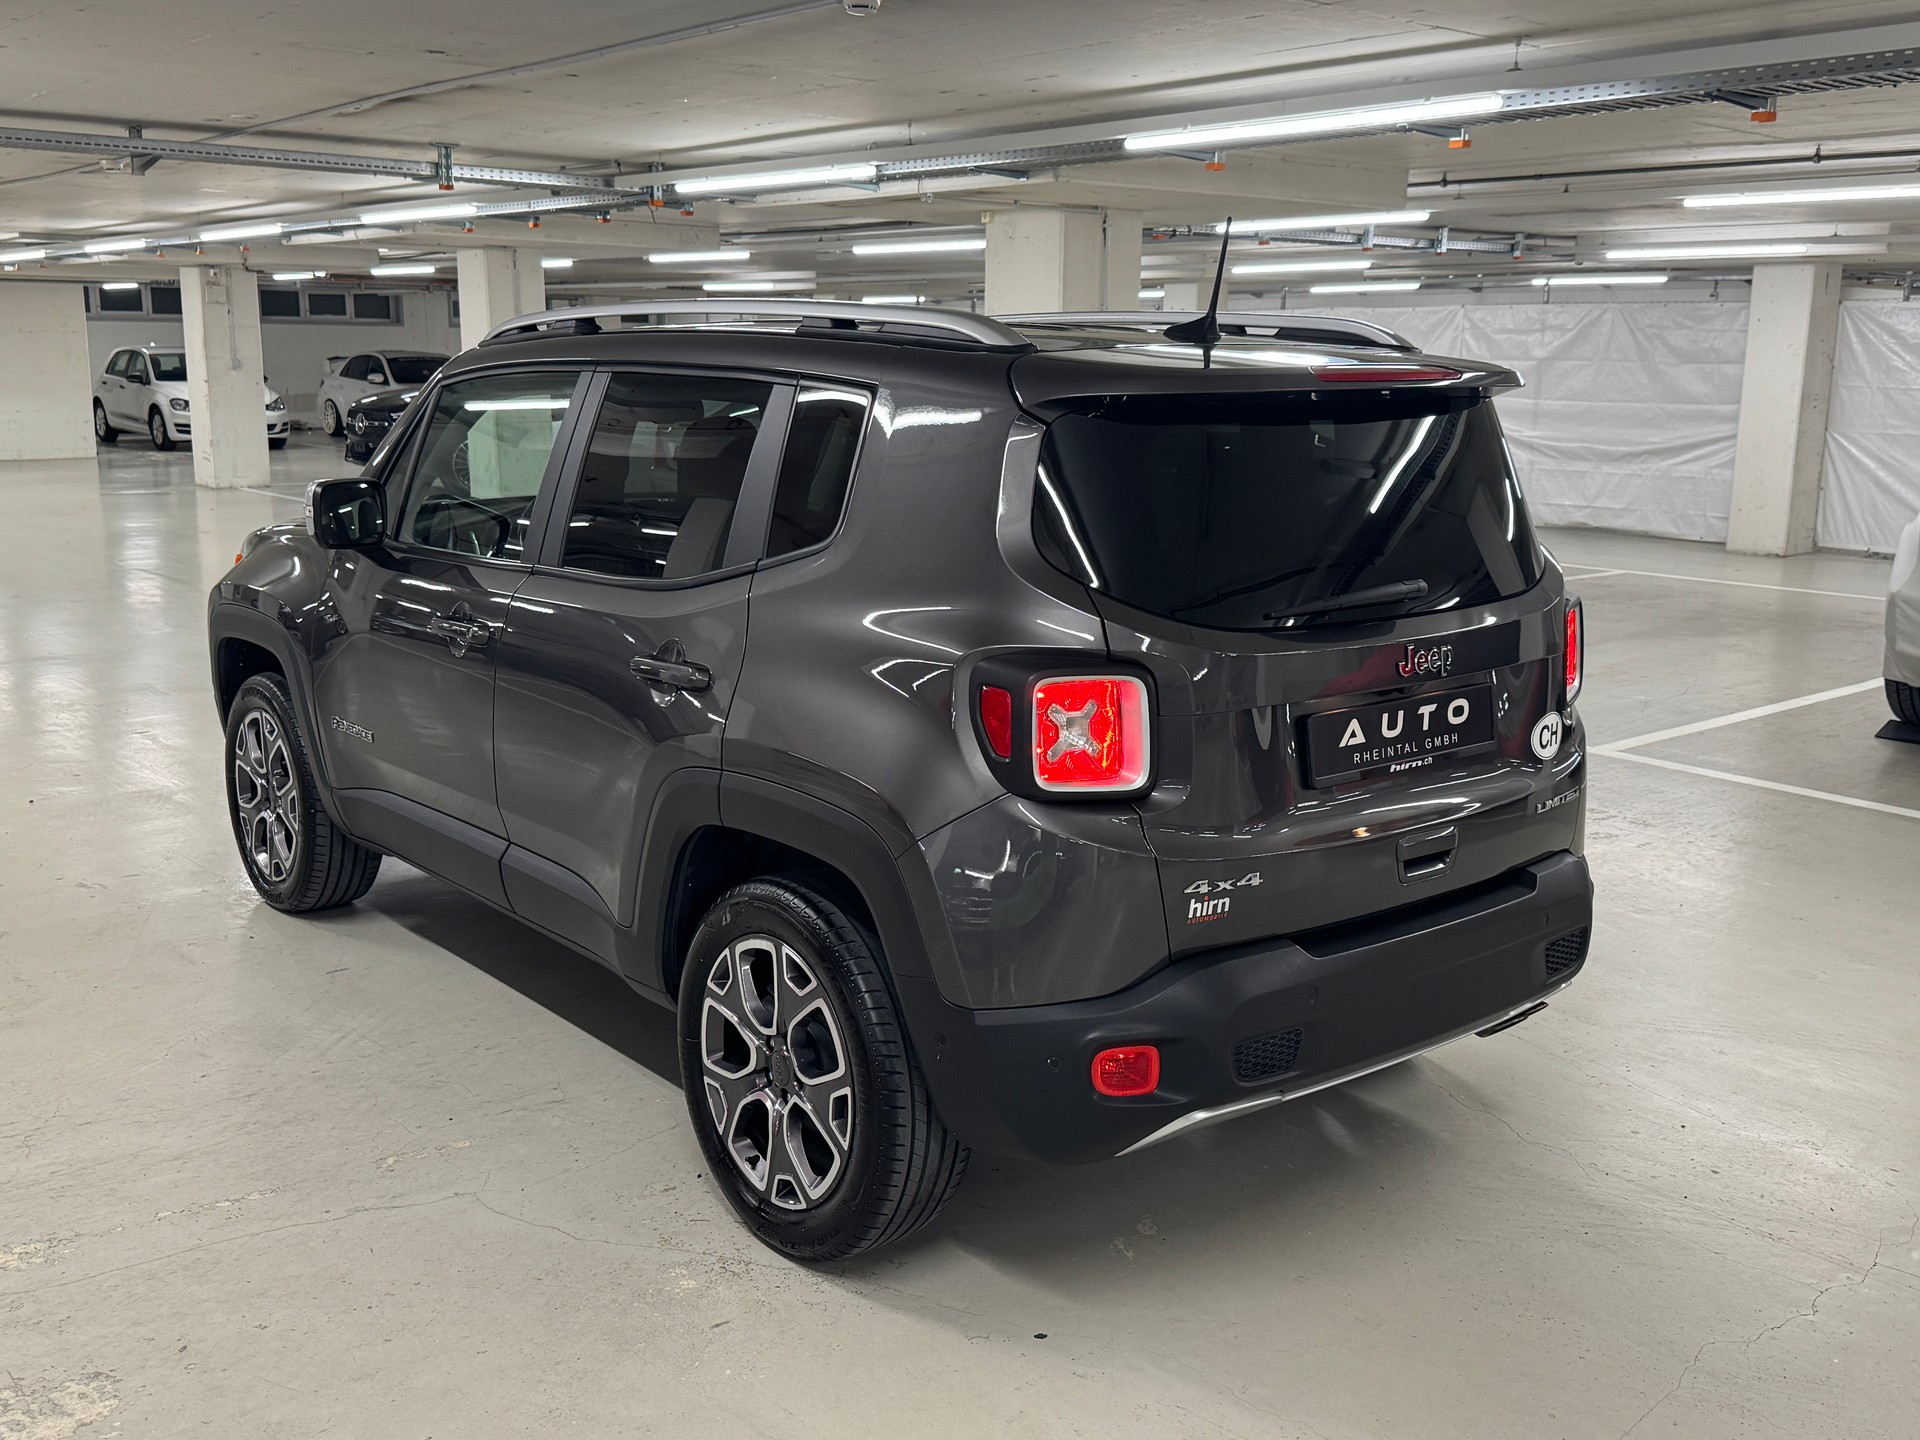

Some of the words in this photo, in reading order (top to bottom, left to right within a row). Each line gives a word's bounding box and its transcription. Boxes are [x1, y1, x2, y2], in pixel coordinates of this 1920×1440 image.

[1399, 644, 1453, 677] Jeep
[1339, 698, 1470, 748] AUTO
[1540, 721, 1559, 750] CH
[1353, 741, 1419, 764] RHEINTAL
[1425, 732, 1459, 749] GMBH
[1390, 756, 1433, 772] hirn.ch
[1184, 872, 1264, 894] 4x4
[1188, 896, 1230, 918] hirn
